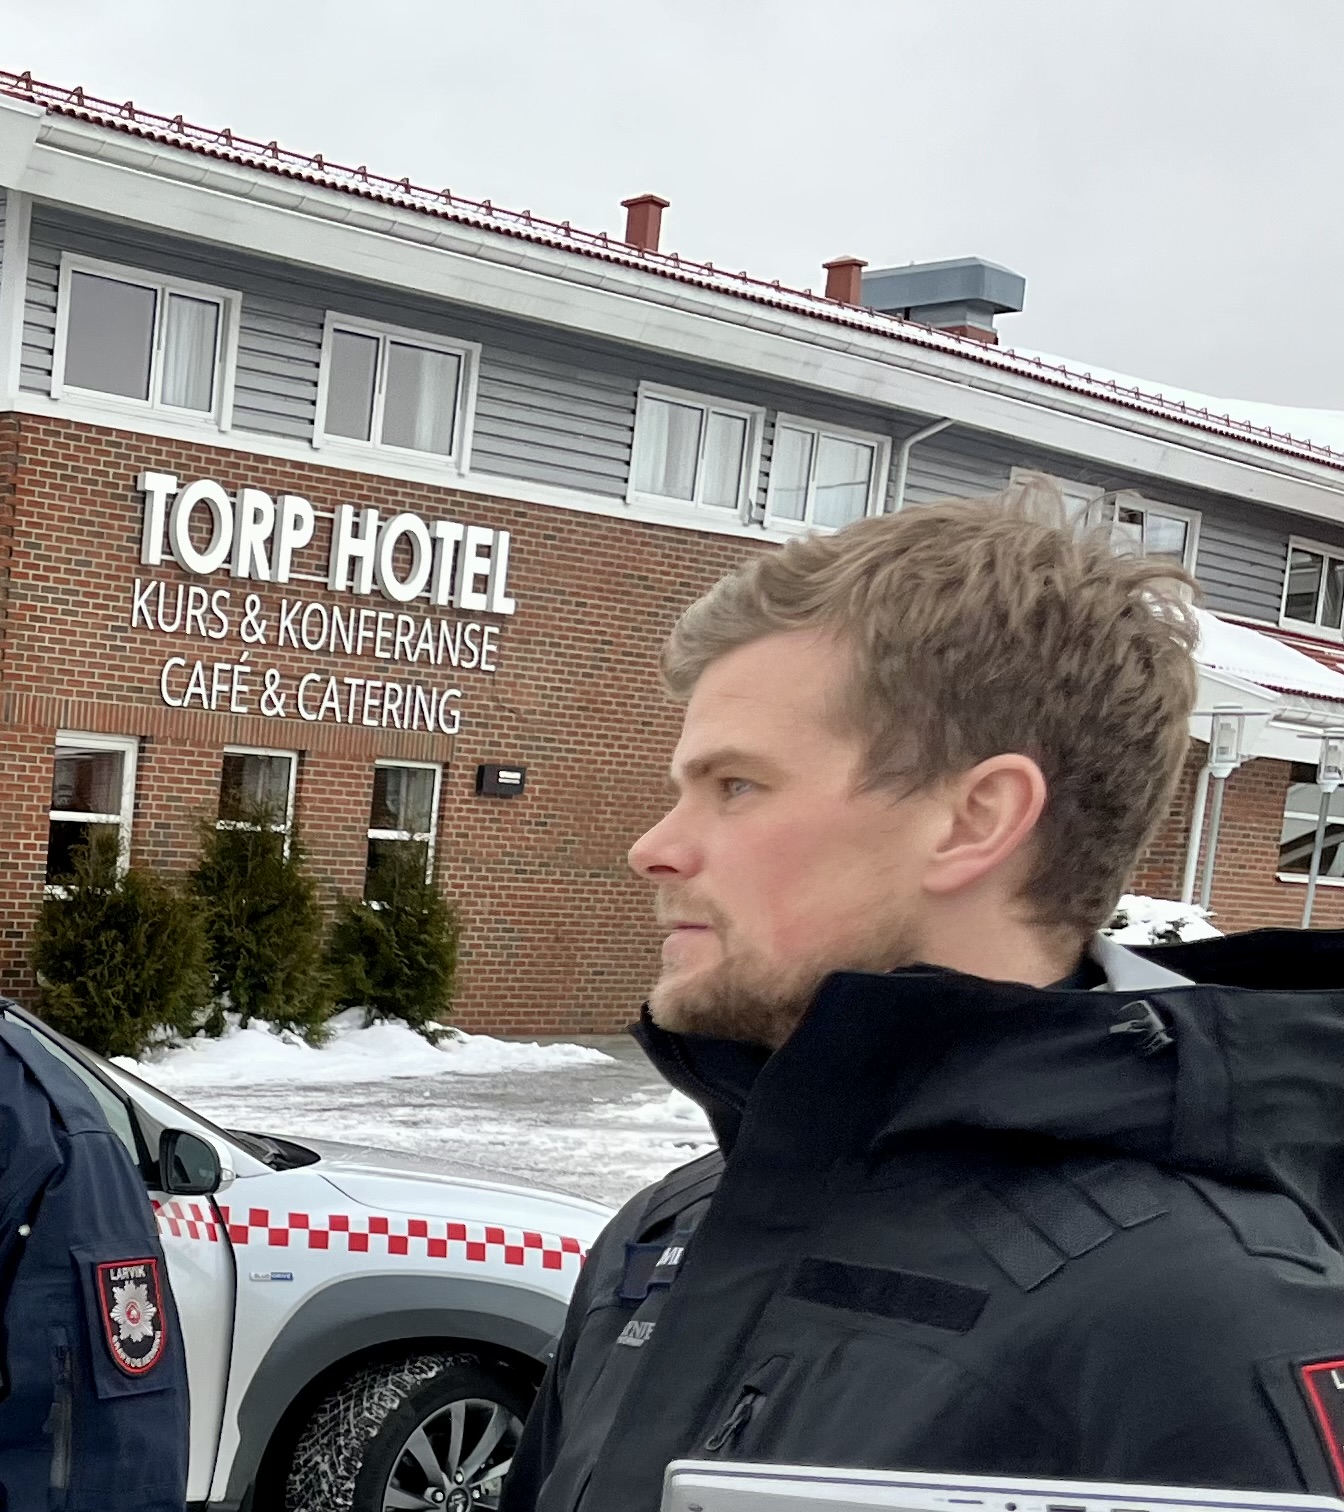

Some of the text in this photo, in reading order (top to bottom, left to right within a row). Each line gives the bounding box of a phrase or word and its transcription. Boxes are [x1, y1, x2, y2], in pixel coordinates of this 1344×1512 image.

[136, 471, 516, 614] TORP HOTEL
[131, 578, 500, 672] KURS & KONFERANSE
[160, 650, 462, 734] CAFÉ & CATERING
[109, 1265, 146, 1280] LARVIK
